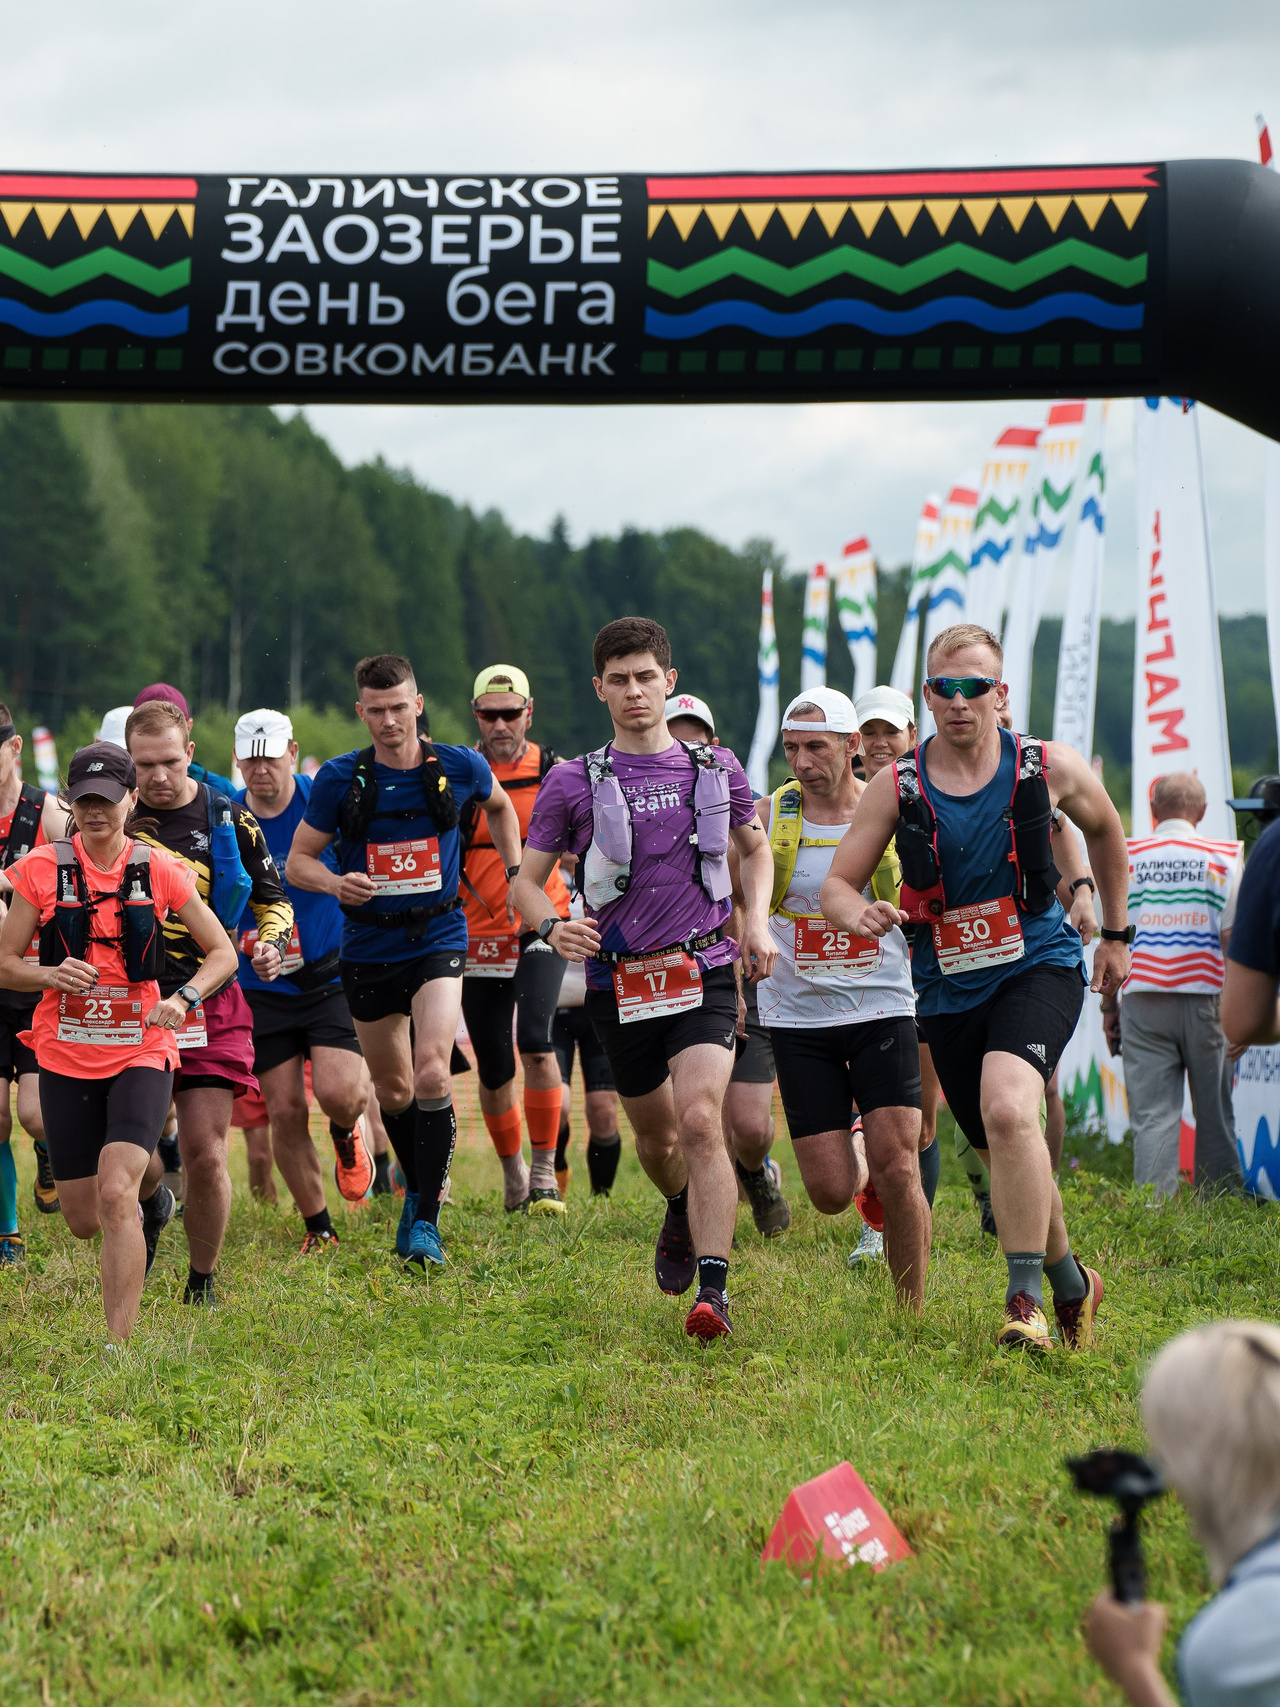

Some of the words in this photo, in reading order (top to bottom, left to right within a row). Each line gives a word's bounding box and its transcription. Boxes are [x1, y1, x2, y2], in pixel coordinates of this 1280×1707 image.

[227, 177, 623, 208] ГАЛИЧСКОЕ
[221, 213, 622, 265] ЗАОЗЕРЬЕ
[216, 280, 406, 332] день
[446, 265, 616, 326] бега
[211, 342, 617, 376] СОВКОМБАНК
[390, 853, 417, 873] 36
[1136, 860, 1205, 871] ГАЛИЧСКОЕ
[1136, 871, 1205, 884] ЗАОЗЕРЬЕ
[1138, 911, 1209, 927] ОЛОНТЁР
[956, 918, 991, 943] 30
[477, 942, 500, 958] 43
[666, 946, 683, 955] RING
[821, 931, 851, 951] 25
[962, 939, 994, 950] Владислав
[643, 970, 668, 992] 17
[84, 999, 113, 1019] 23
[82, 1018, 116, 1026] Александра
